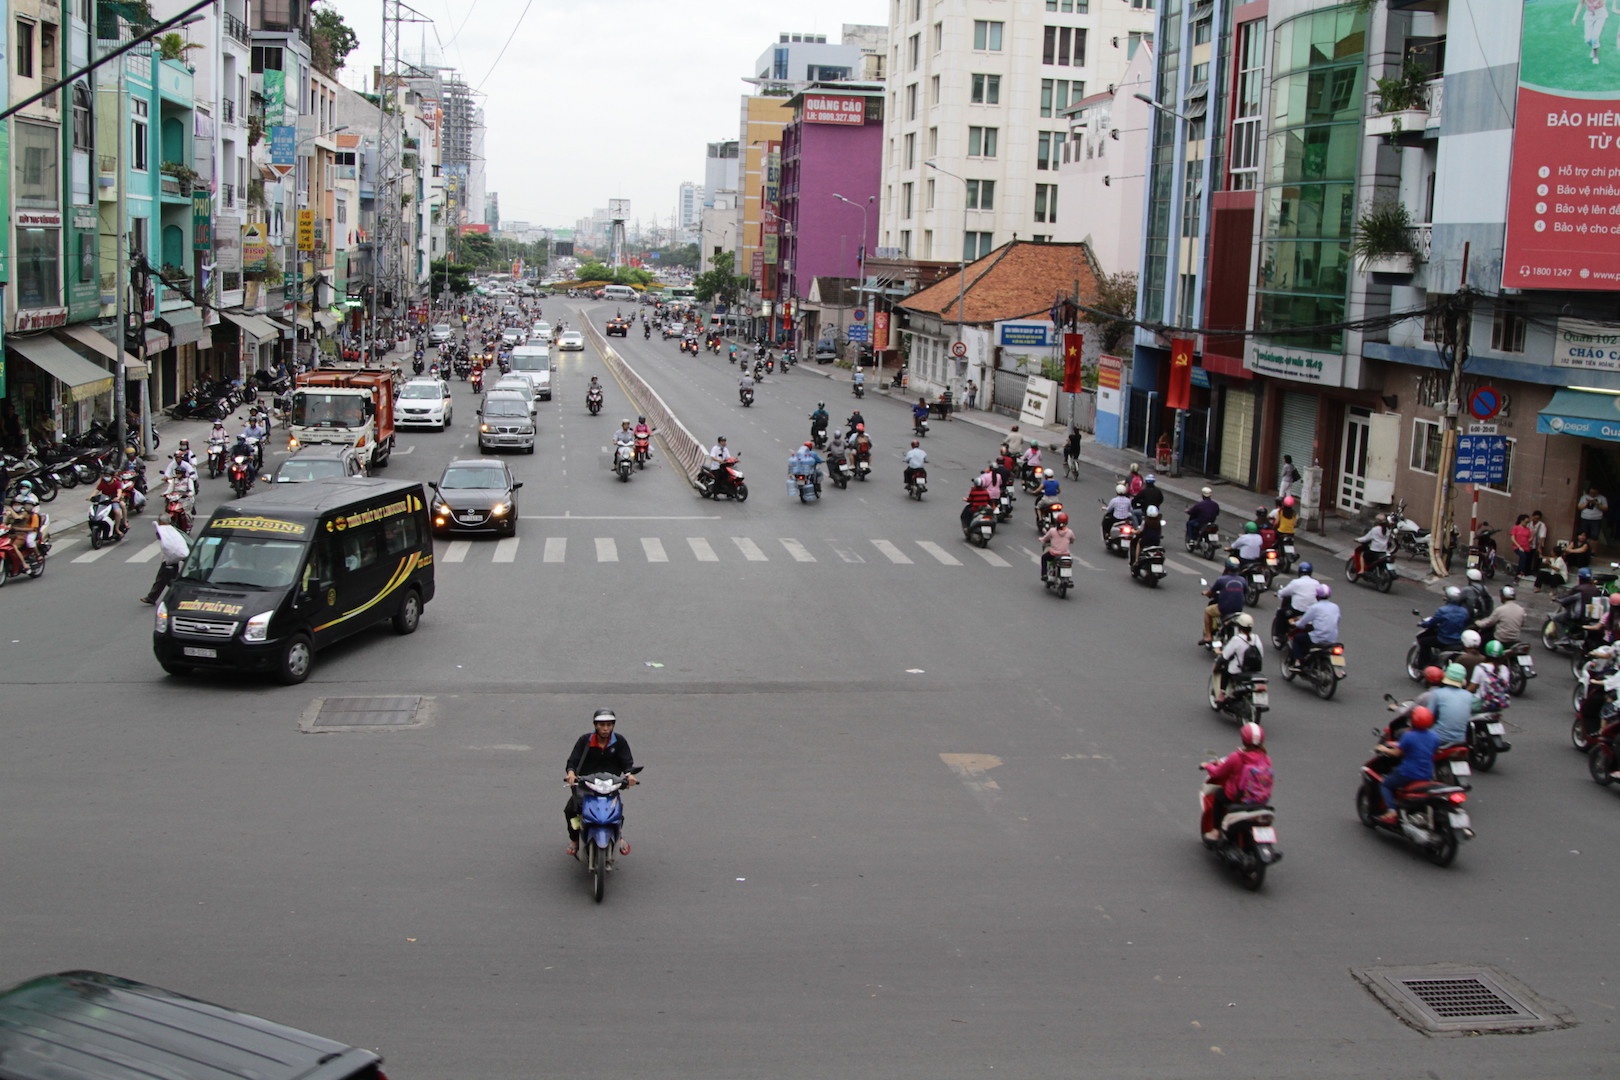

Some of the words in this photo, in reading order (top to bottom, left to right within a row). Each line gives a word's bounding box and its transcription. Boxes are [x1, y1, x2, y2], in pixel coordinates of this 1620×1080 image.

[842, 99, 862, 112] CÁO
[1547, 110, 1582, 127] BẢO
[1588, 131, 1612, 149] TỪ
[1558, 165, 1572, 176] Hỗ
[1592, 167, 1606, 176] chi
[1557, 184, 1576, 195] Bảo
[1555, 203, 1575, 213] Bảo
[1554, 222, 1573, 232] Bảo
[1590, 224, 1608, 233] cho
[1533, 267, 1551, 276] 1800
[1553, 268, 1572, 277] 1247
[1569, 346, 1604, 359] CHÁO
[1564, 422, 1590, 432] pepsi
[210, 517, 306, 534] LIMOUSINE
